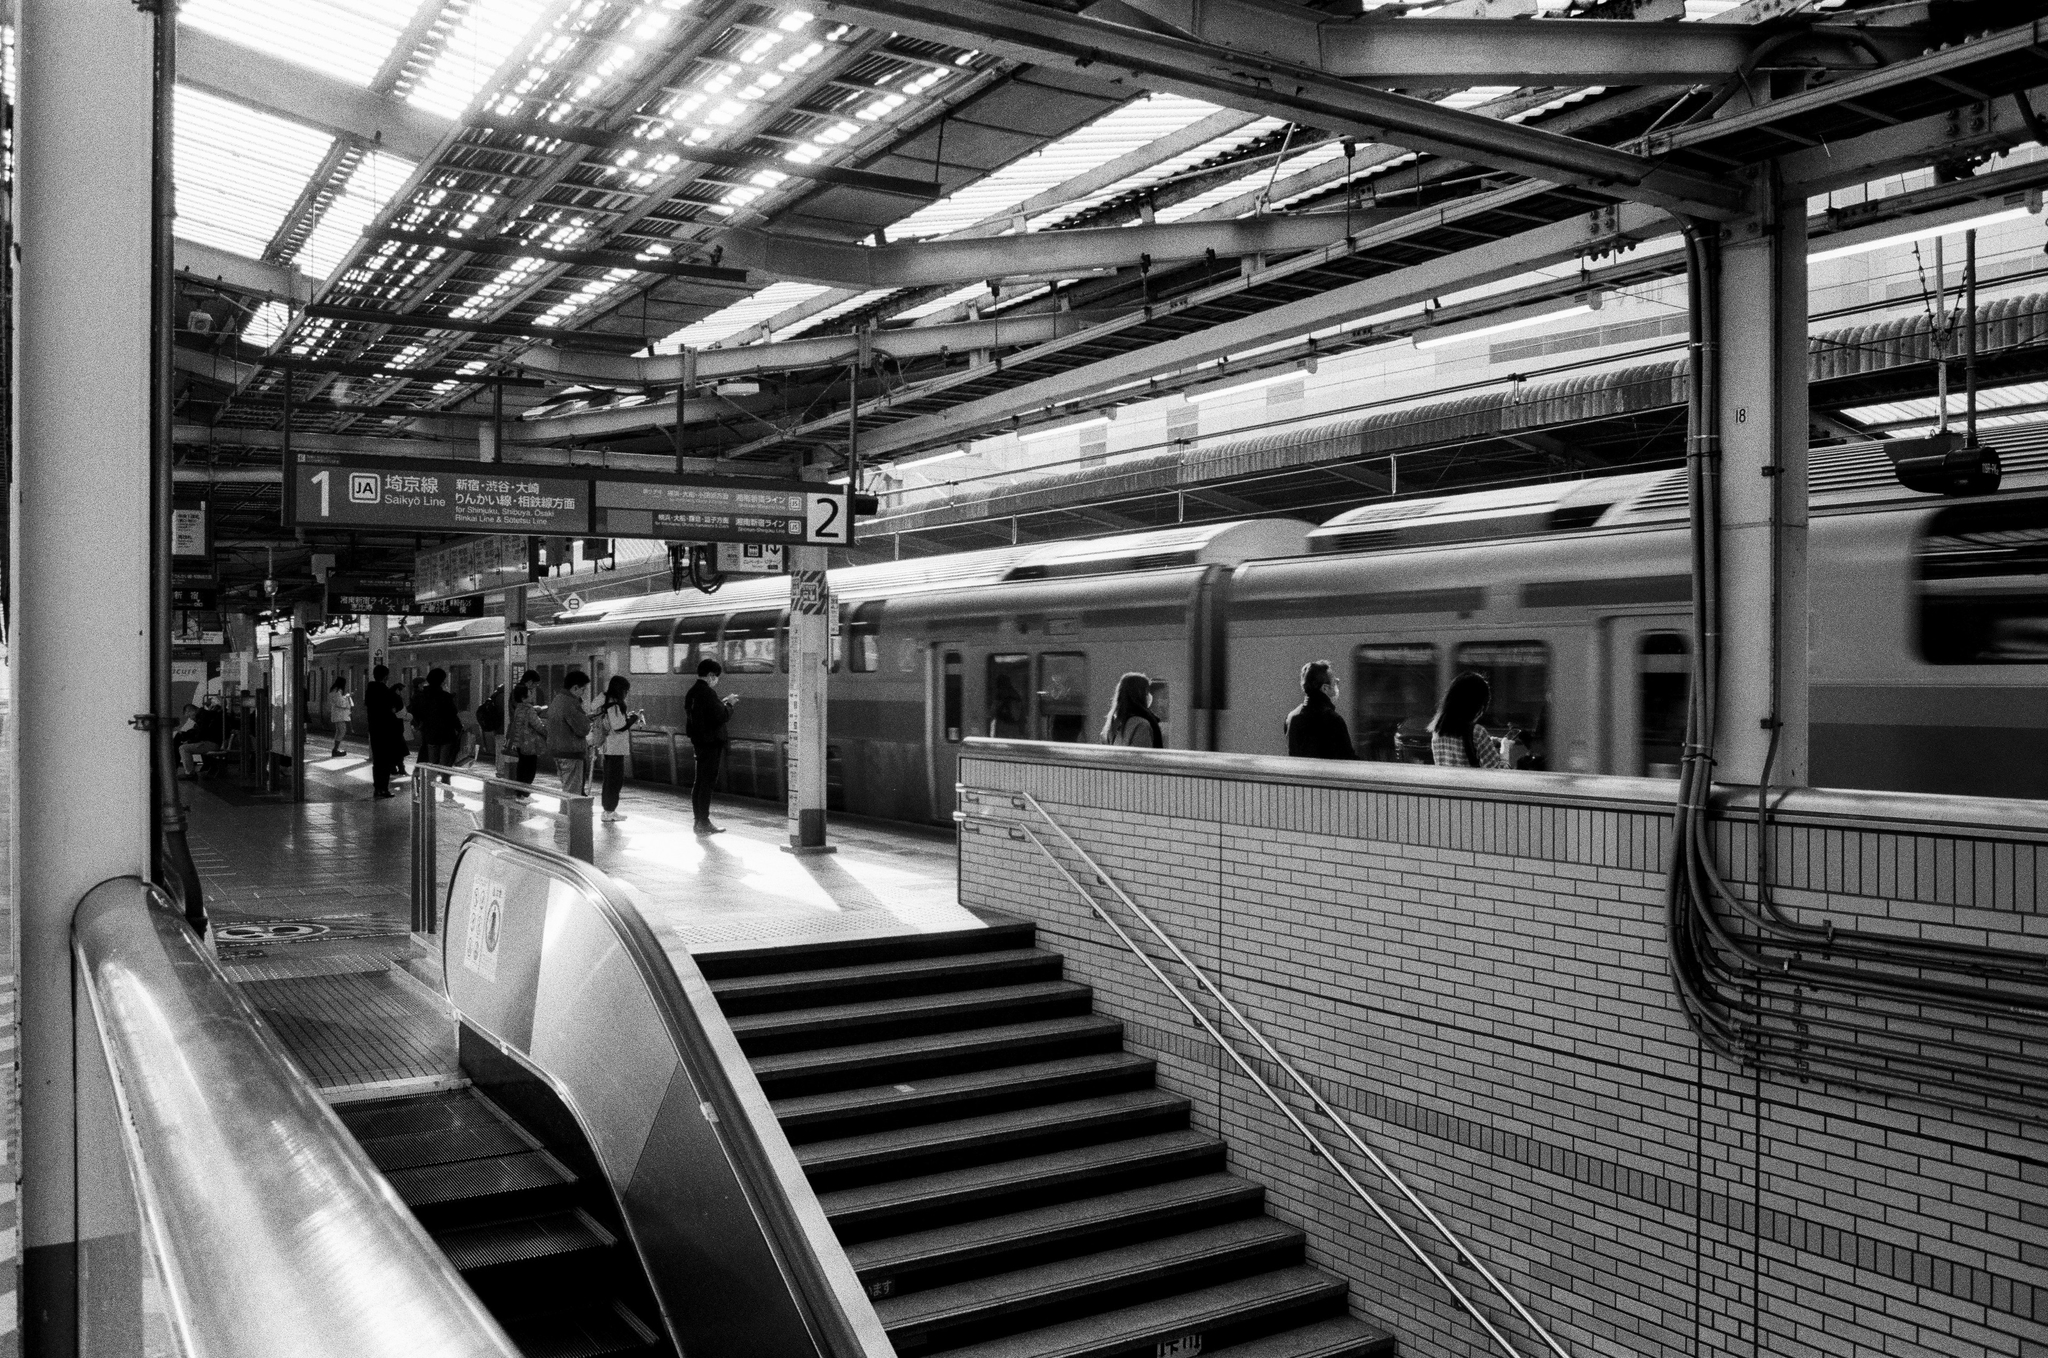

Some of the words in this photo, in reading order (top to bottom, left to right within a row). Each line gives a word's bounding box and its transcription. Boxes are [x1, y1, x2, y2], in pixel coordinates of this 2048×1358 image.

[1735, 409, 1746, 423] 18
[355, 482, 374, 495] JA
[384, 474, 439, 494] 埼京線
[456, 478, 540, 495] 新宿・渋谷・大崎
[310, 470, 330, 517] 1
[423, 496, 446, 507] Line
[455, 492, 575, 510] りんかい線・相鉄線方面
[455, 506, 465, 514] for
[455, 514, 478, 522] Rinkai
[479, 515, 494, 523] Line
[532, 517, 548, 525] Line
[814, 497, 839, 538] 2
[568, 598, 580, 610] 8
